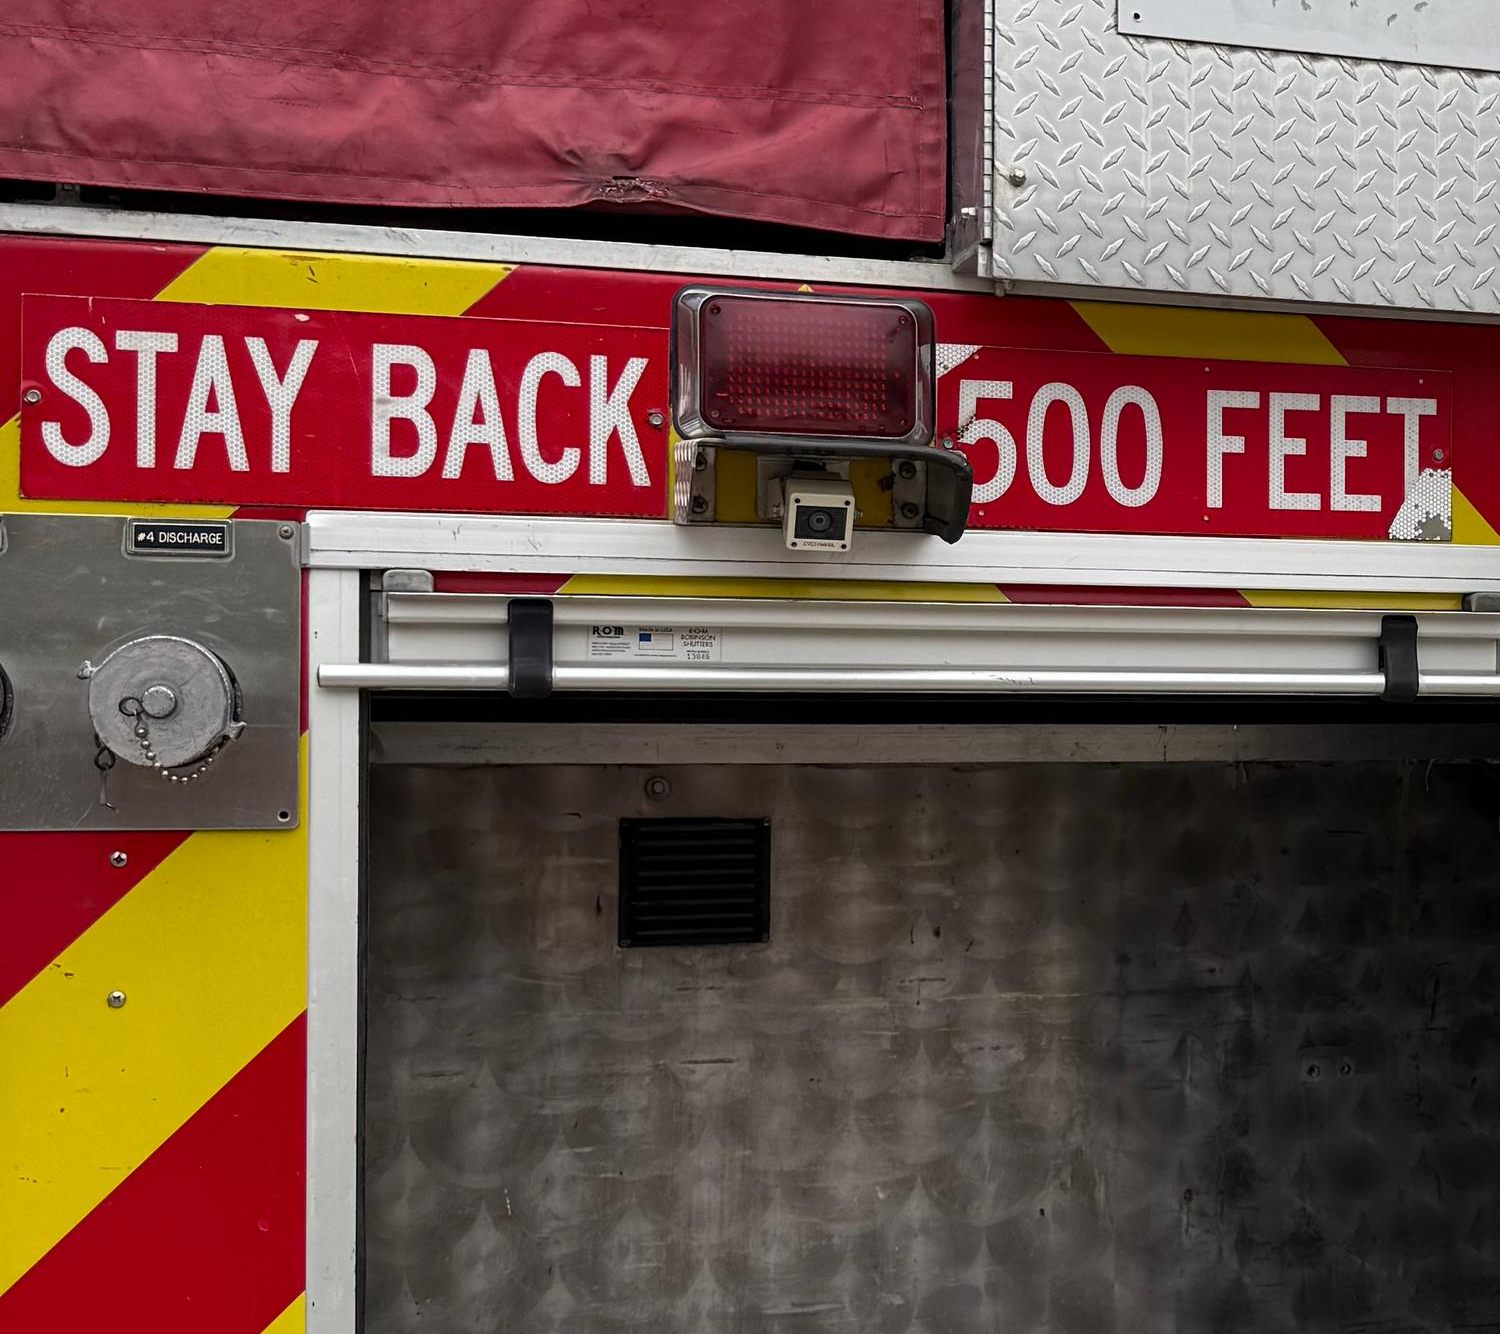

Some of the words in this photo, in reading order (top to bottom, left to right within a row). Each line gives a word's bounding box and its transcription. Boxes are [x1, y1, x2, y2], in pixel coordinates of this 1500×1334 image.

[42, 327, 319, 472] STAY
[372, 344, 651, 486] BACK
[957, 379, 1164, 507] 500
[1206, 389, 1438, 515] FEET
[137, 531, 155, 543] #4
[159, 531, 223, 545] DISCHARGE
